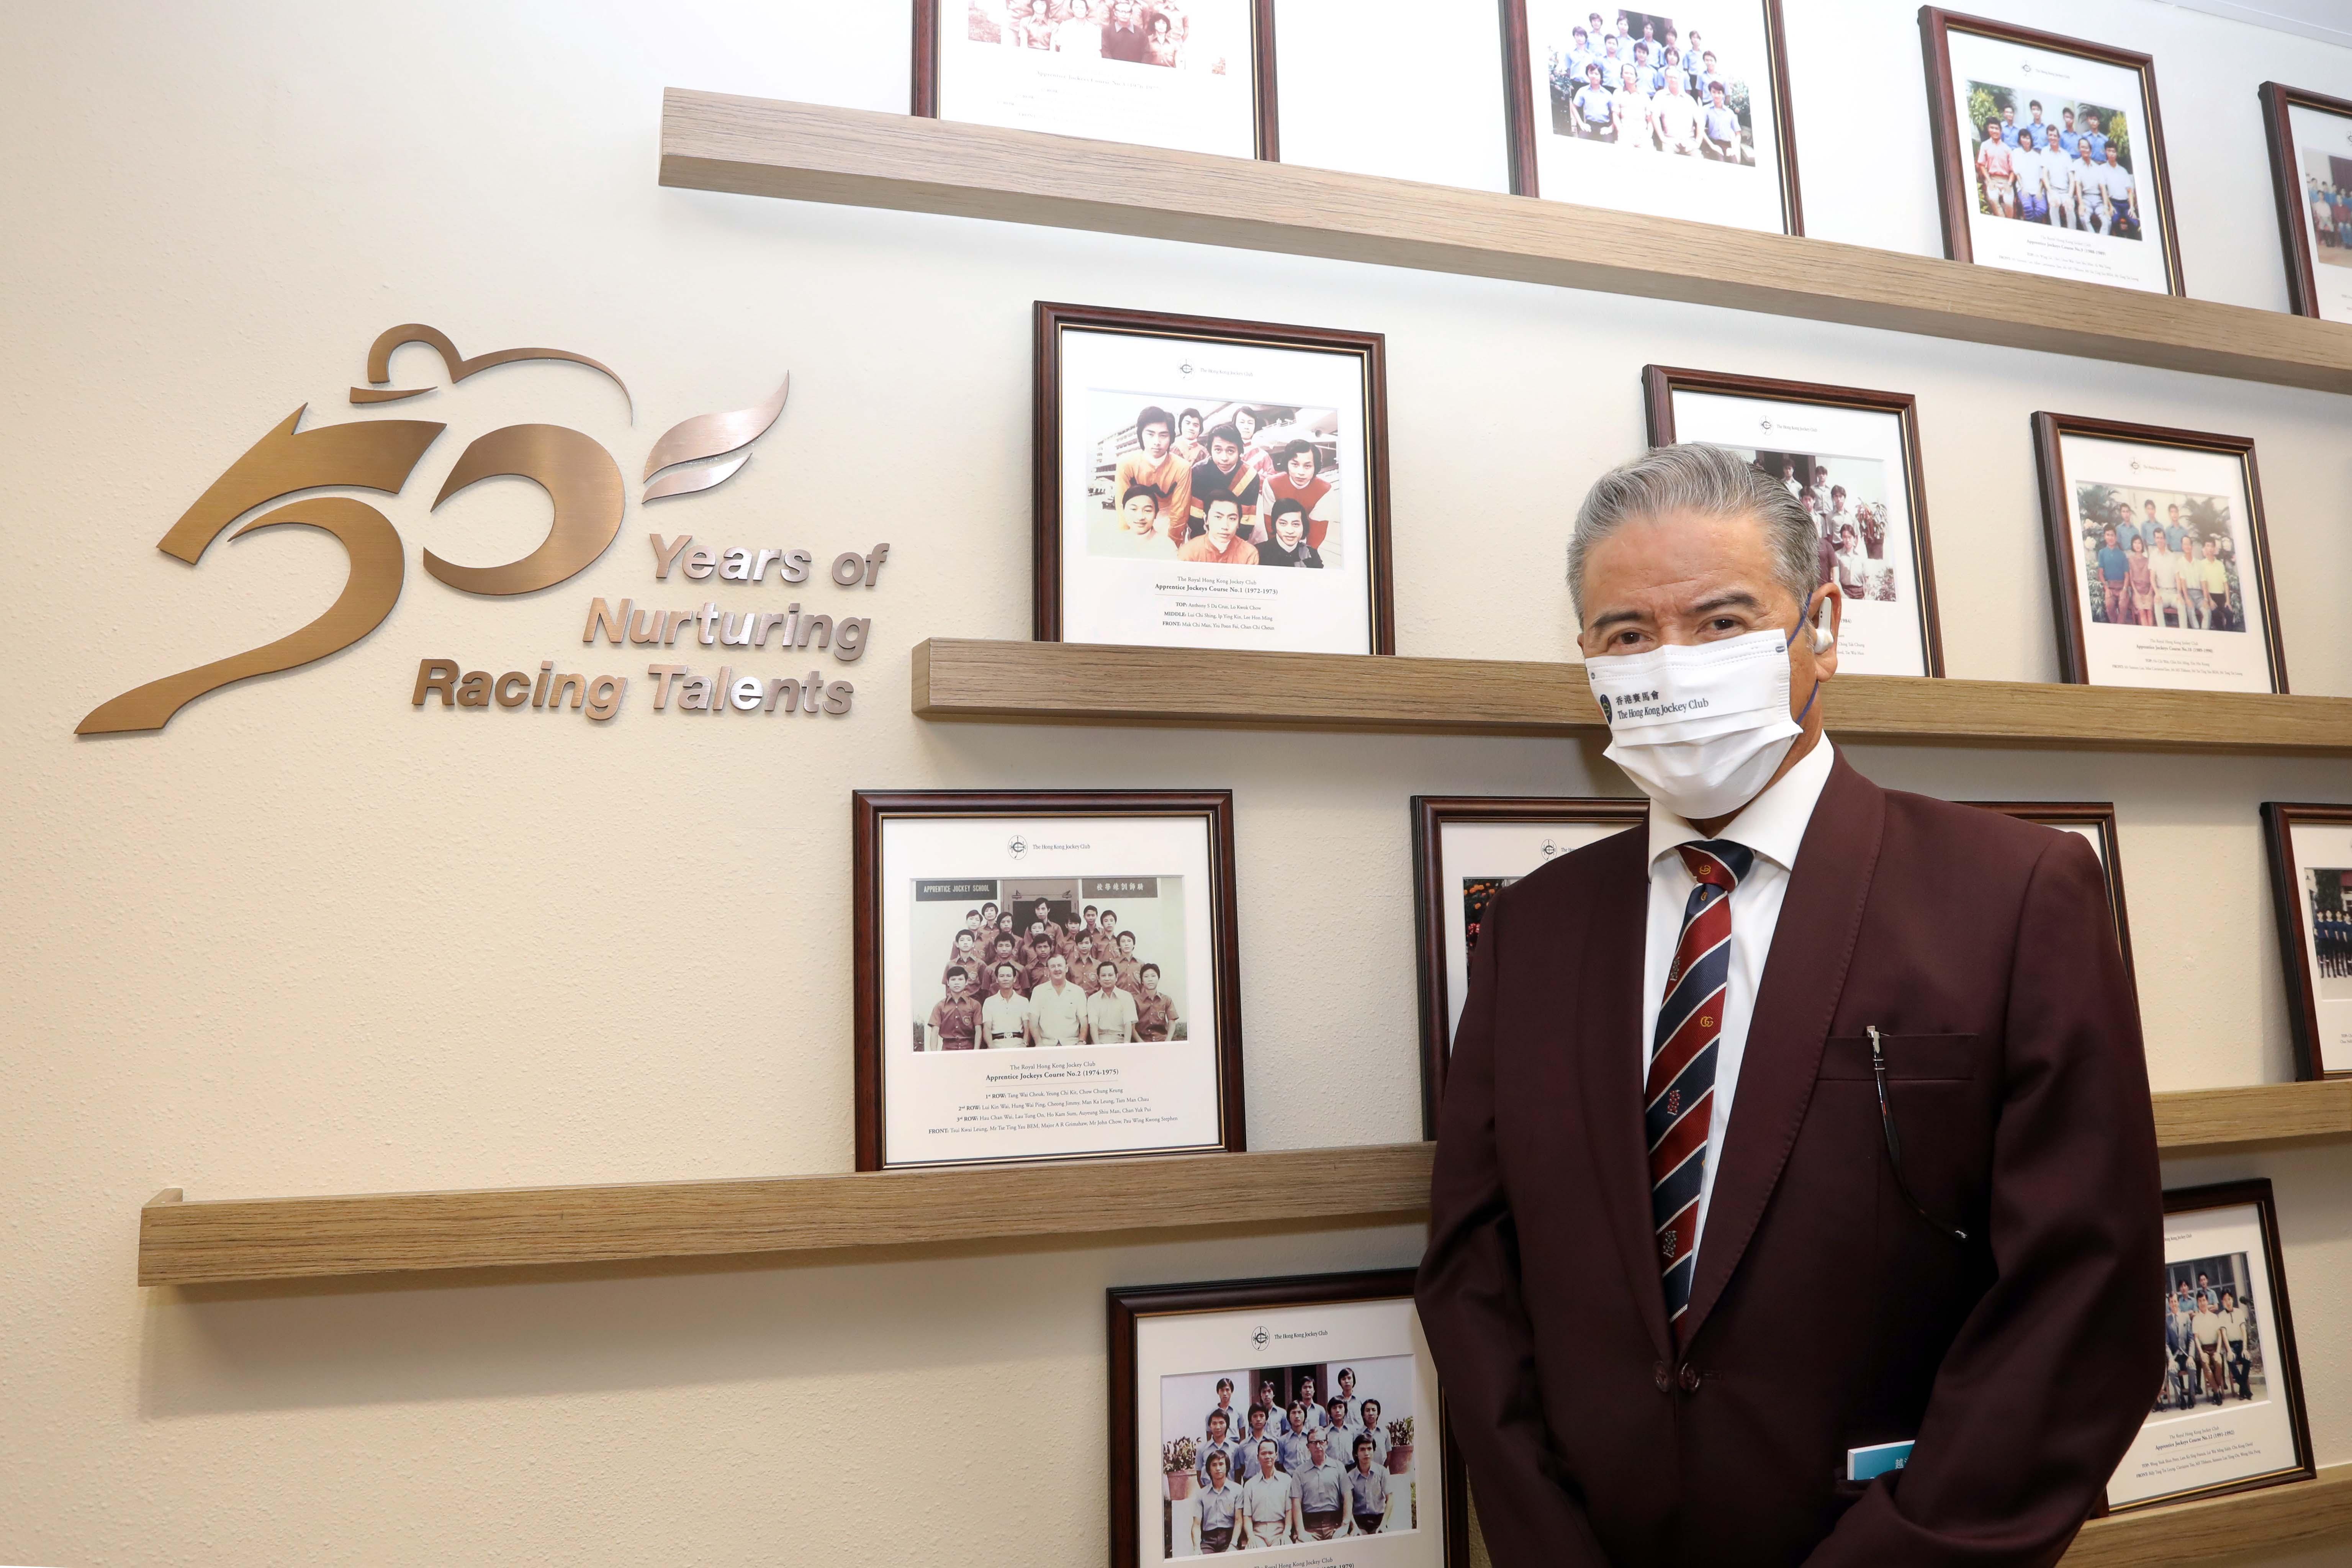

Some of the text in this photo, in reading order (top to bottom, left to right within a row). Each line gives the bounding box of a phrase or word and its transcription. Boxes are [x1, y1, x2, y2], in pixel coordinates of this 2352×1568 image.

[649, 533, 812, 583] Years
[831, 543, 890, 587] of
[582, 597, 871, 662] Nurturing
[411, 658, 854, 722] Racing Talents
[1615, 690, 1659, 705] 香港賽馬會
[1617, 698, 1709, 720] The Hong Kong Jockey Club
